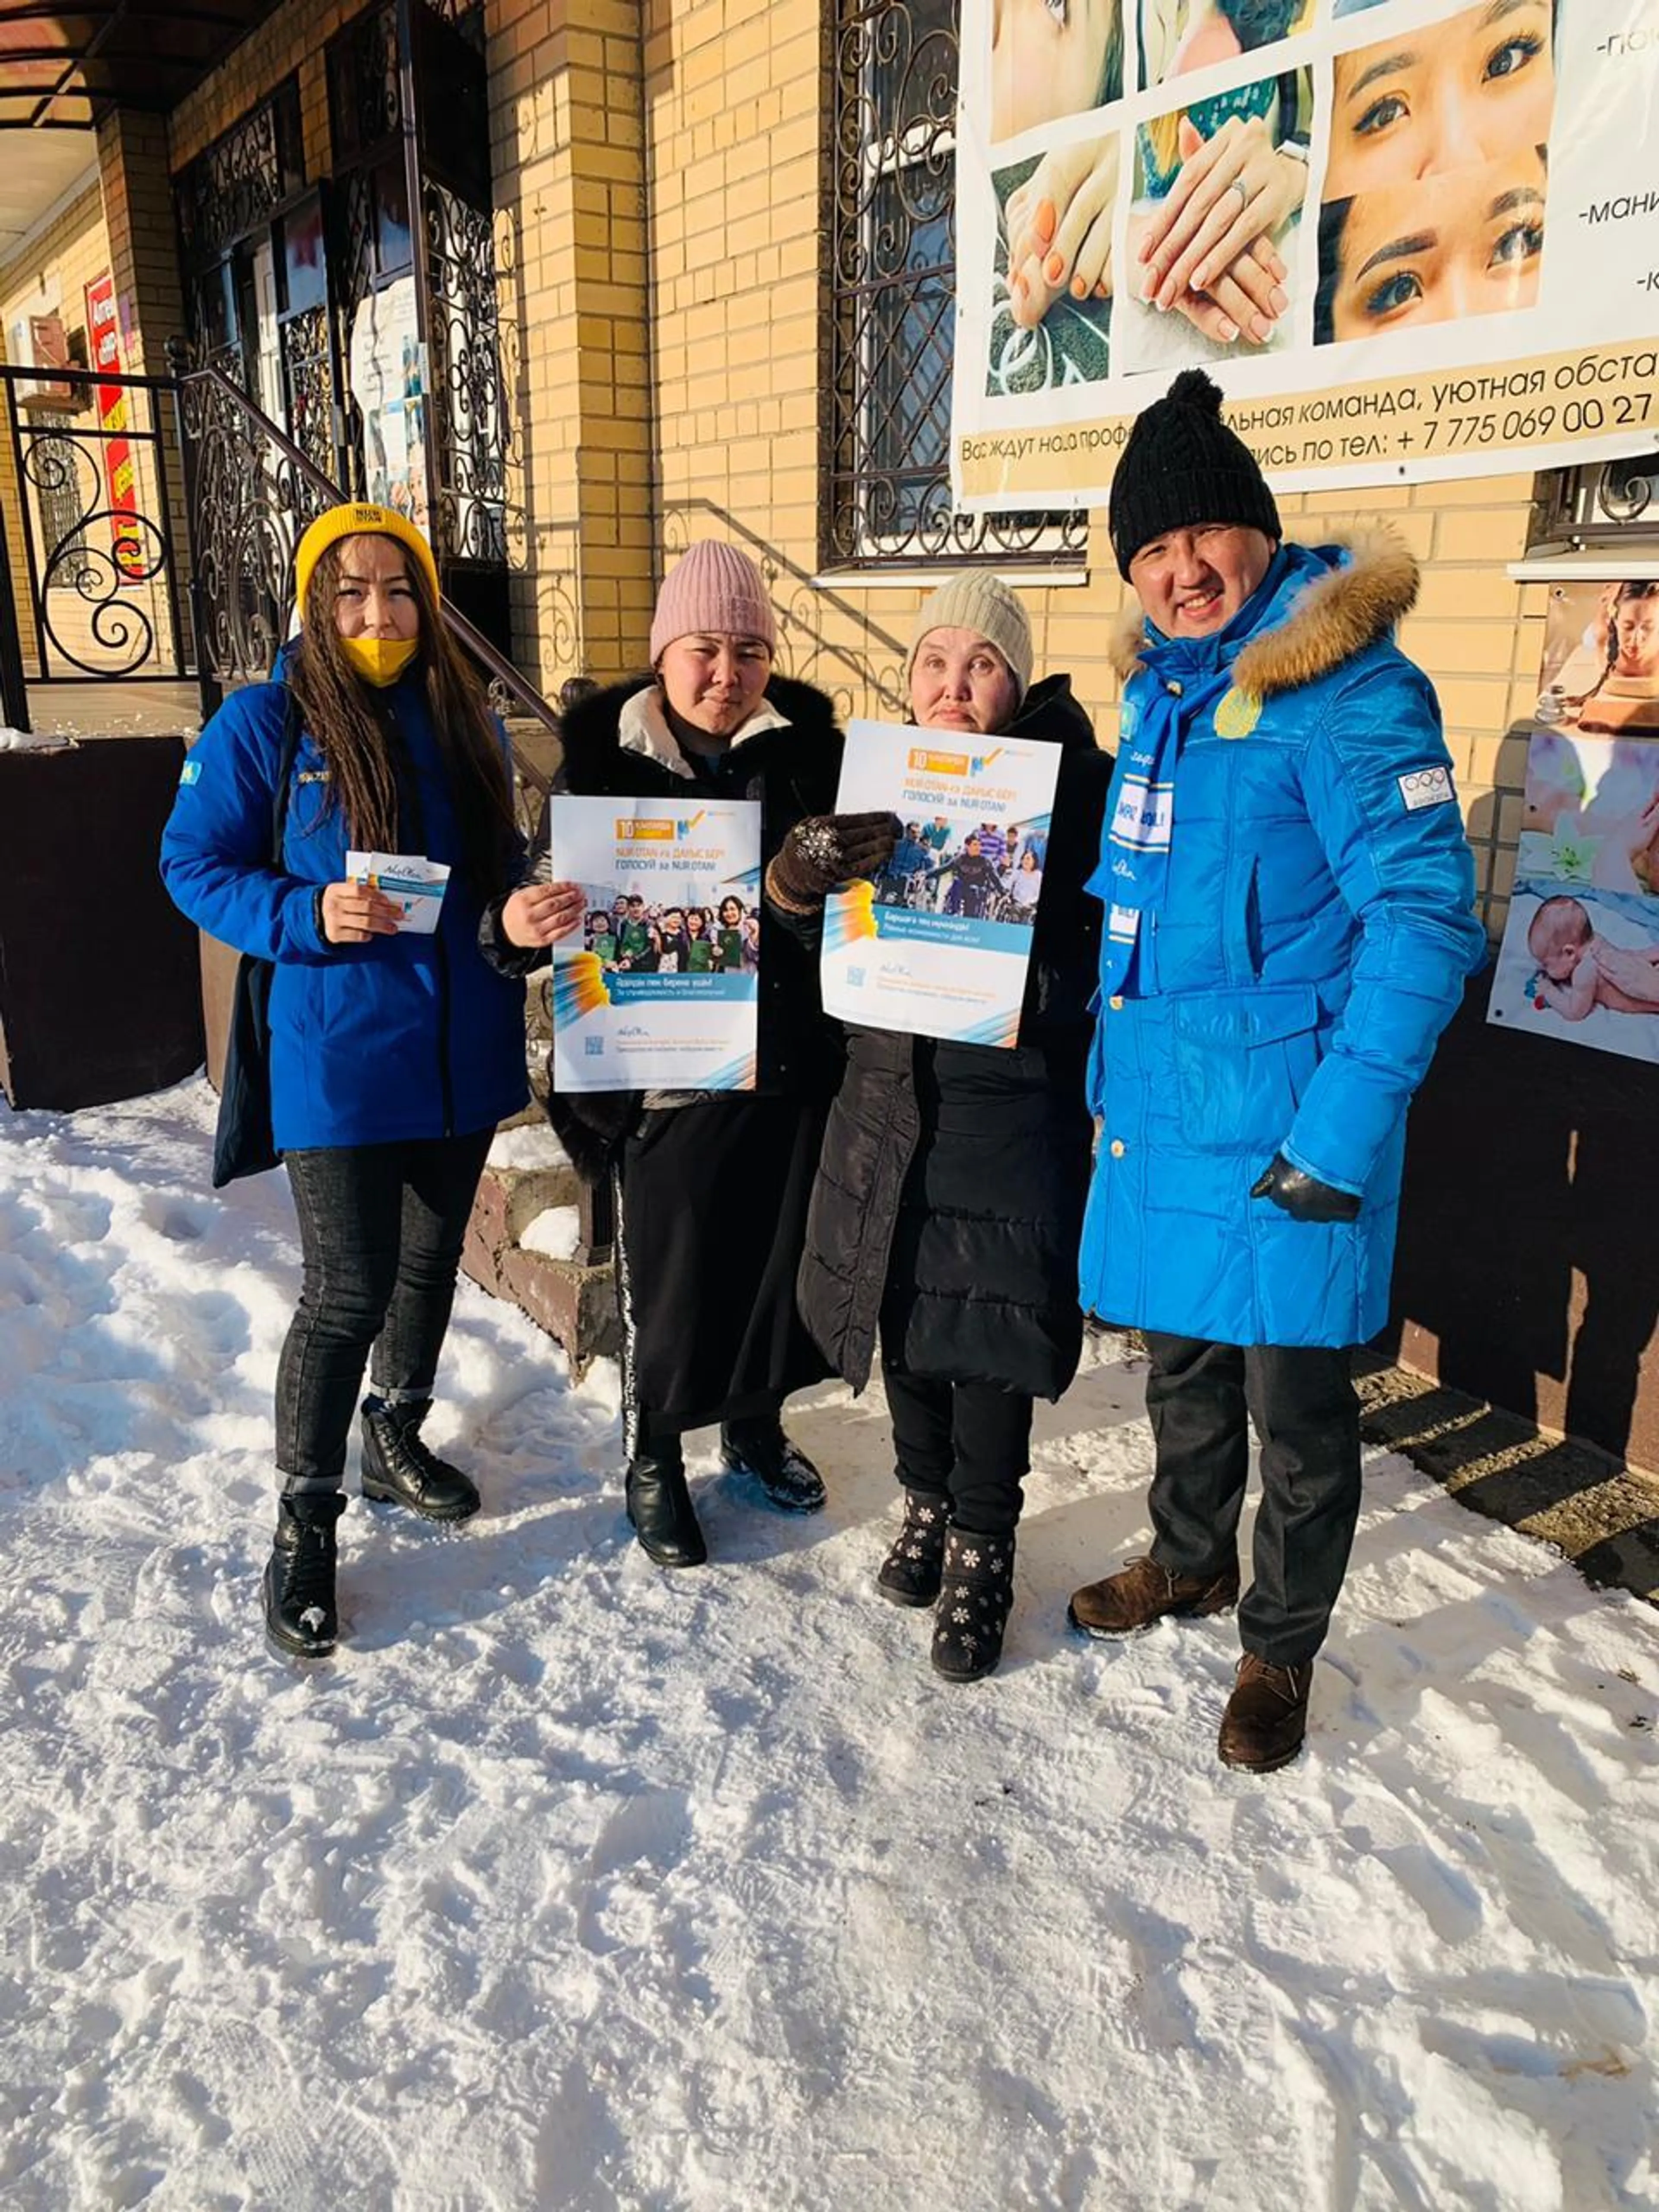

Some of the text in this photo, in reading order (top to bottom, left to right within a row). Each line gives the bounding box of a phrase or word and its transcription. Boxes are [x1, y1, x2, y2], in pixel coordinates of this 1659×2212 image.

[989, 438, 1035, 460] ждут
[1039, 433, 1077, 452] наа
[1298, 388, 1422, 423] команда,
[1432, 370, 1545, 412] уютная
[1303, 440, 1333, 461] по
[1341, 435, 1387, 457] тел:
[1424, 421, 1439, 449] 7
[1447, 414, 1496, 447] 775
[1503, 405, 1556, 440] 069
[1563, 398, 1604, 432] 00
[1612, 394, 1652, 424] 27
[913, 751, 928, 769] 10
[619, 821, 634, 838] 10
